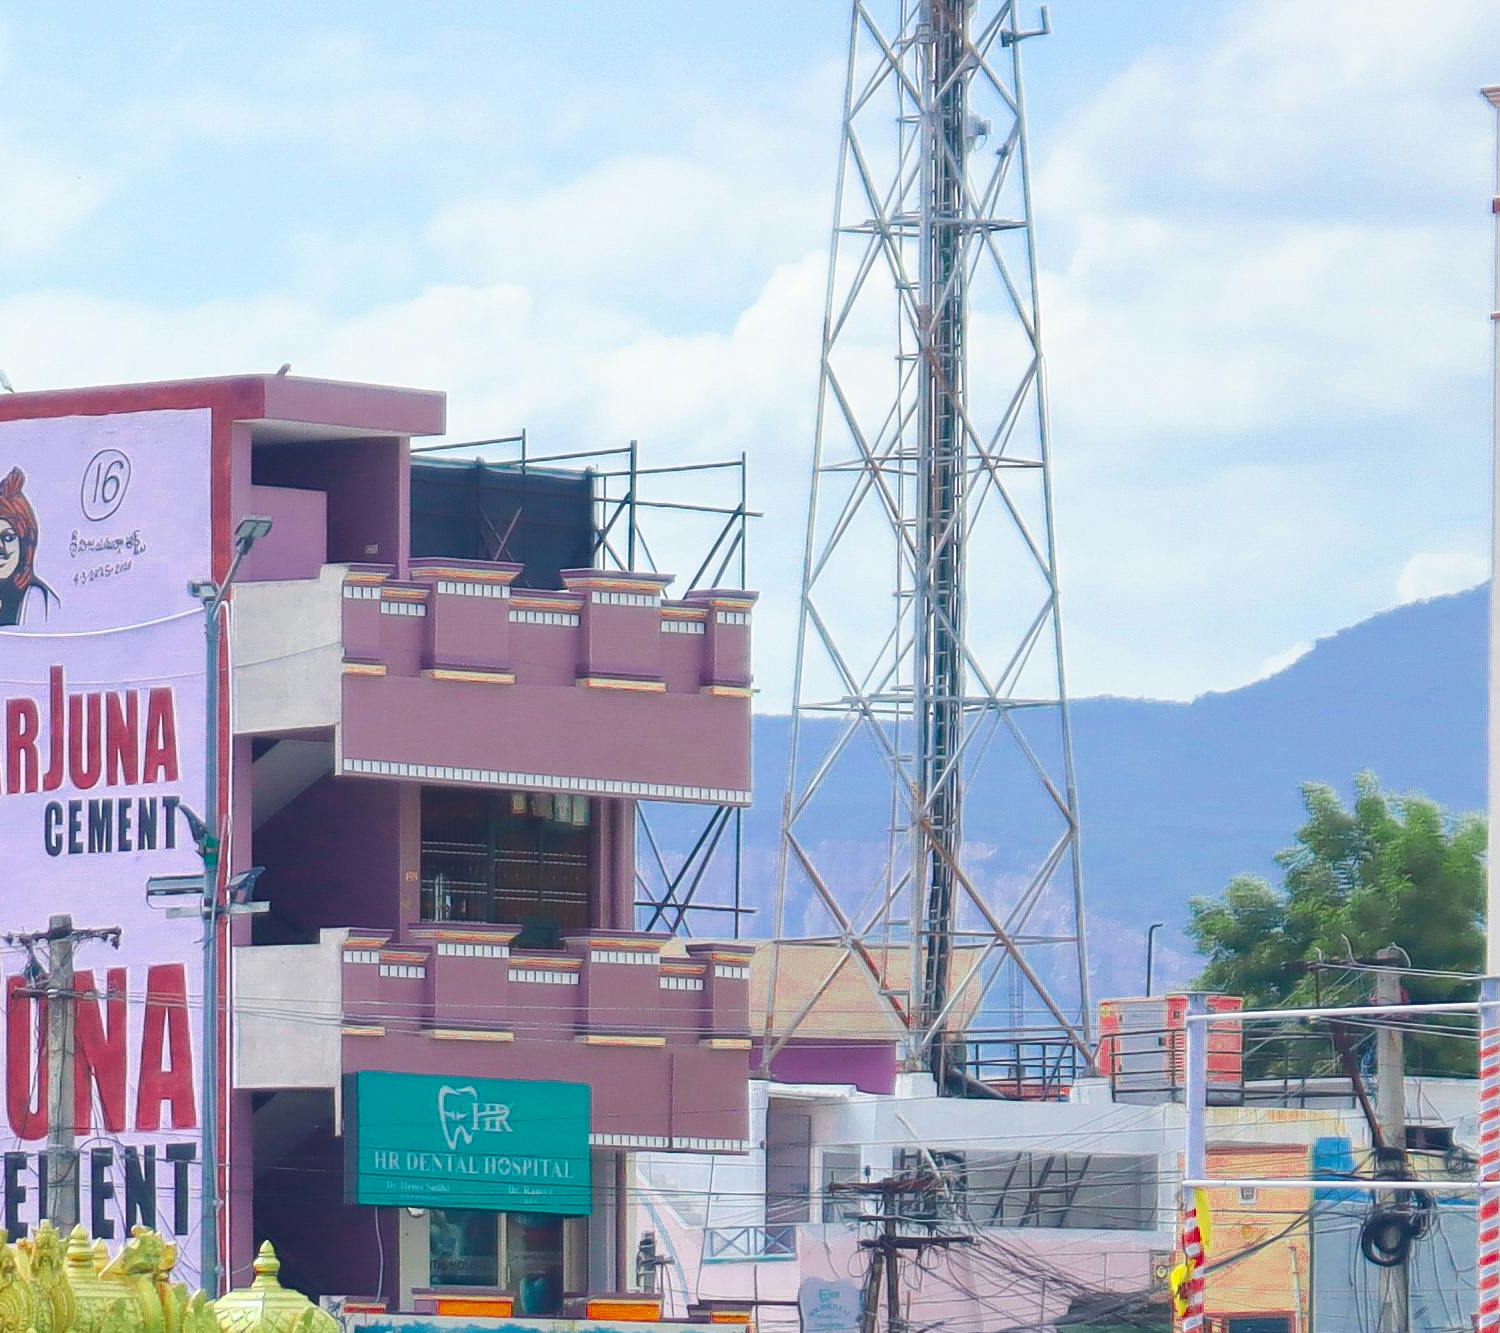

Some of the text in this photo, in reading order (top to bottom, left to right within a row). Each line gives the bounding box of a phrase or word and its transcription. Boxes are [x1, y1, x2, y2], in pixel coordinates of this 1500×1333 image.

[92, 460, 125, 504] 16
[45, 794, 181, 857] CEMENT
[374, 1150, 575, 1179] HR DENTAL HOSPITAL
